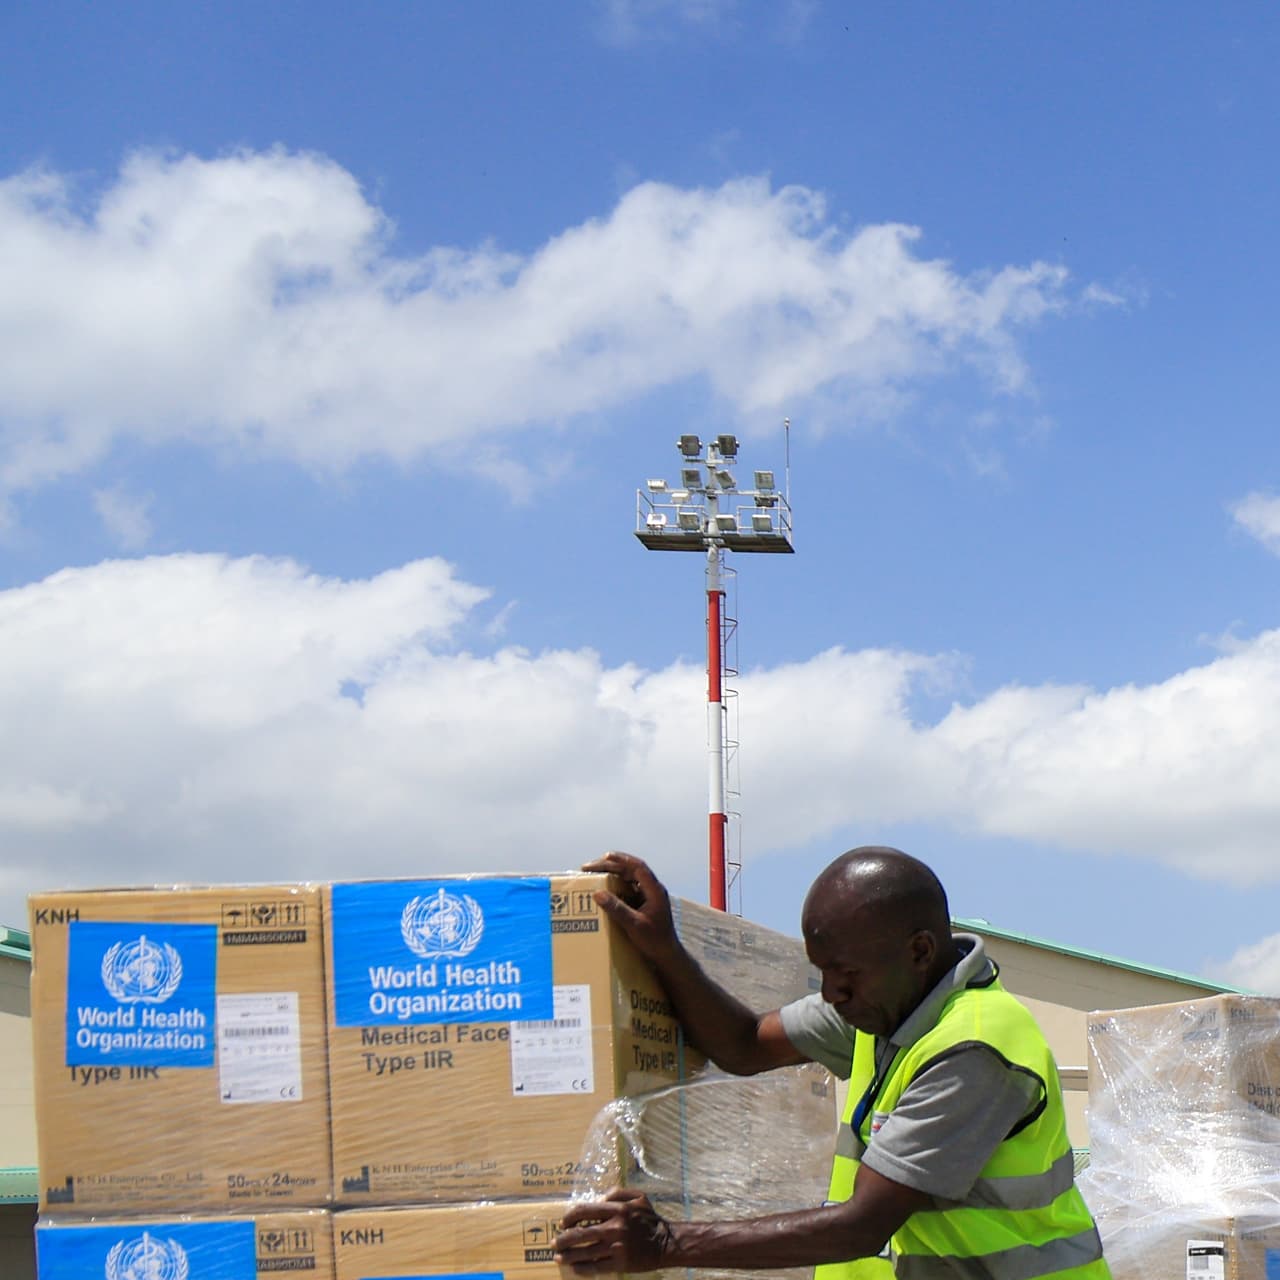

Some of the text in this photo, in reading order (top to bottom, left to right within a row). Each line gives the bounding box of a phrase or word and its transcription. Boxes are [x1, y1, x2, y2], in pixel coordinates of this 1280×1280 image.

[35, 907, 80, 925] KNH
[369, 961, 521, 990] World Health
[369, 988, 522, 1019] Organization
[77, 1007, 206, 1029] World Health
[76, 1029, 206, 1053] Organization
[361, 1025, 510, 1046] Medical Face
[362, 1051, 453, 1075] Type IIR
[633, 1045, 658, 1072] Type
[70, 1066, 121, 1086] Type
[340, 1228, 384, 1245] KNH
